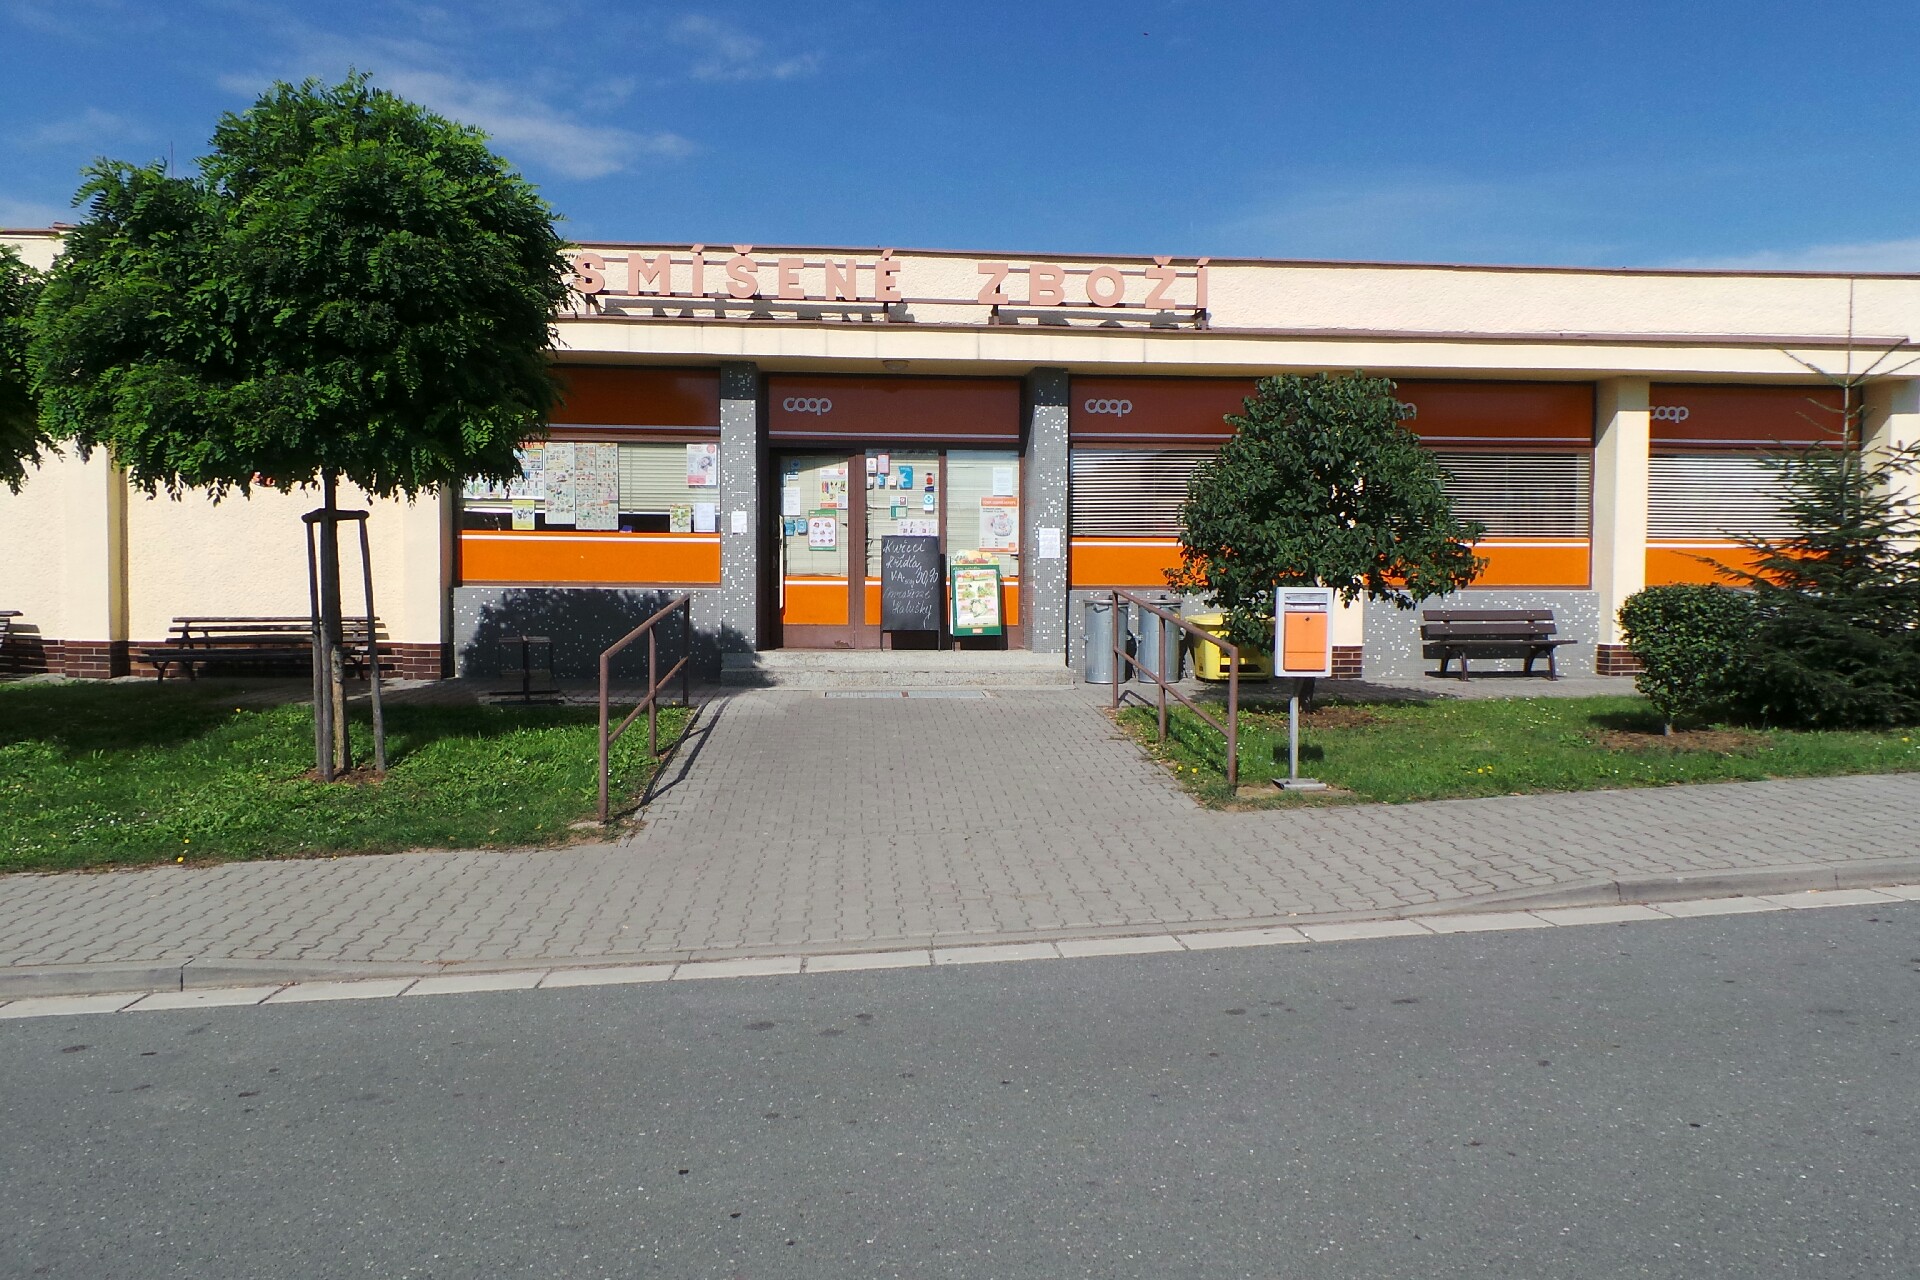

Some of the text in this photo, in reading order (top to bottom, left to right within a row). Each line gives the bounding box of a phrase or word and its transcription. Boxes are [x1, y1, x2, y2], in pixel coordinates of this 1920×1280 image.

[573, 244, 1210, 309] SMÍŠENÉ ZBOŽÍ
[783, 397, 832, 416] coop
[1085, 399, 1133, 417] coop
